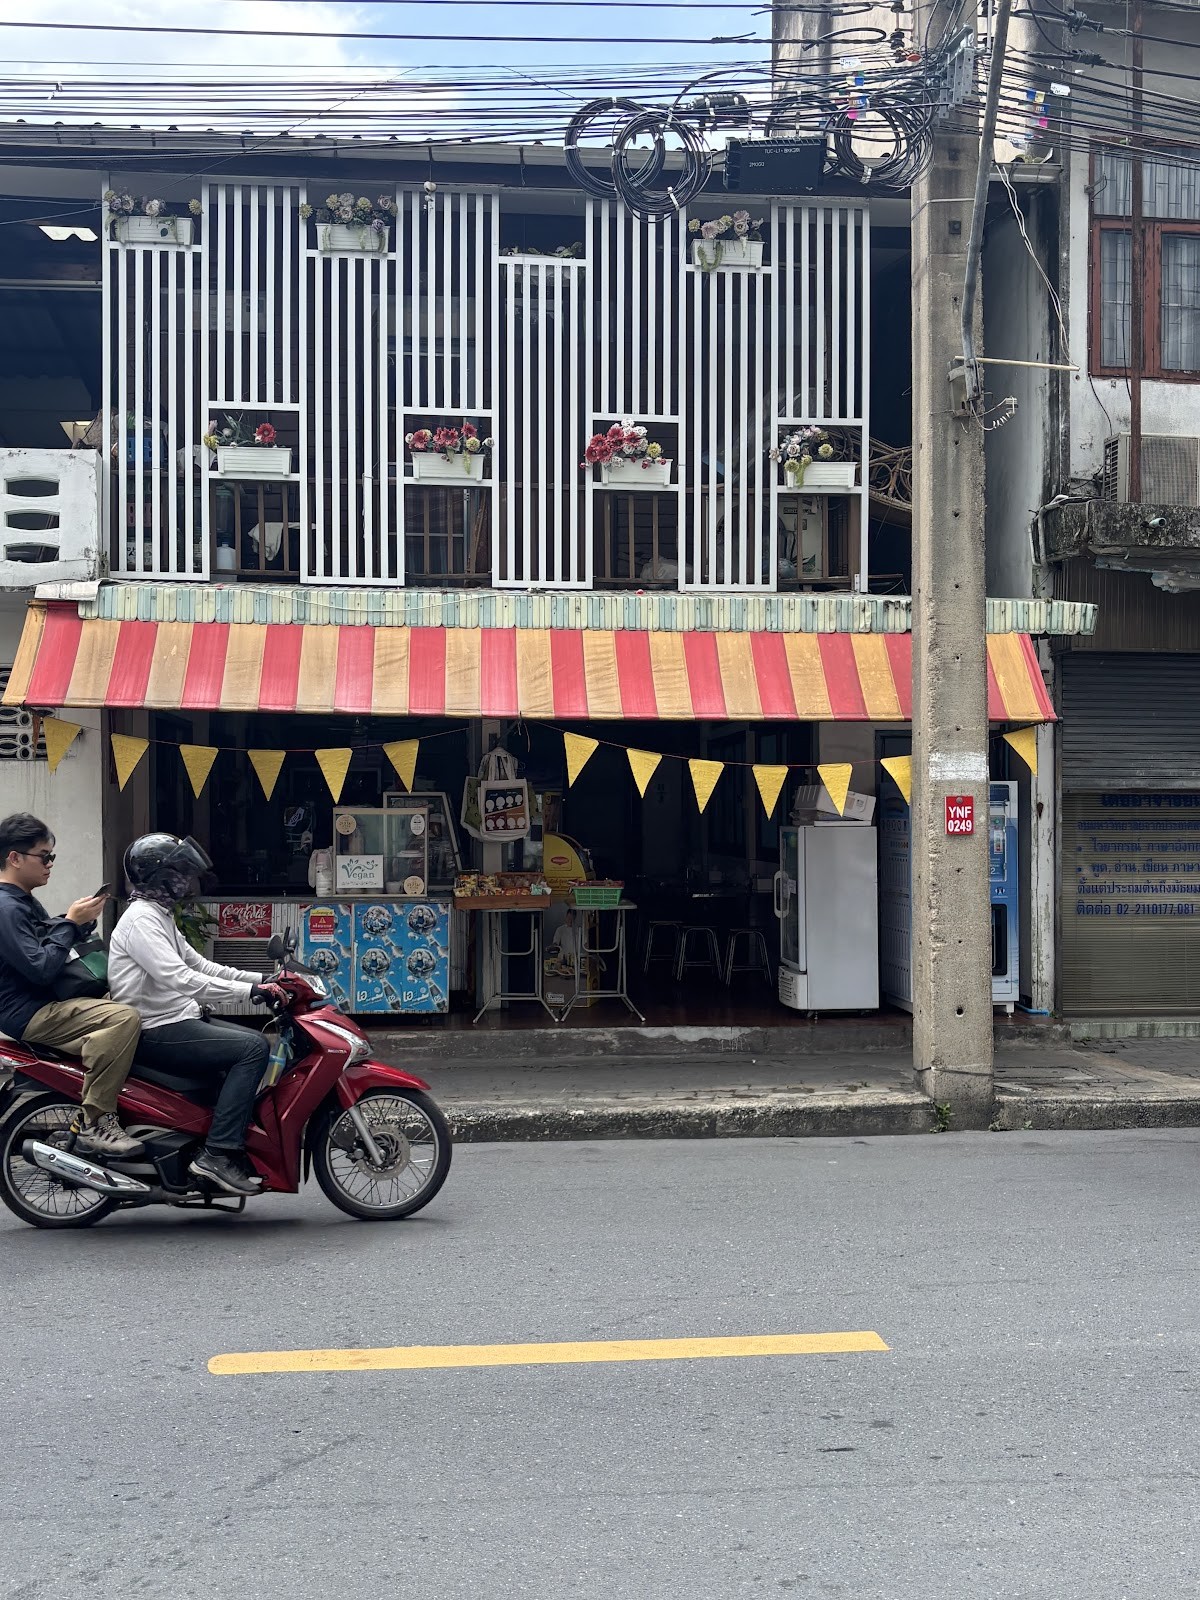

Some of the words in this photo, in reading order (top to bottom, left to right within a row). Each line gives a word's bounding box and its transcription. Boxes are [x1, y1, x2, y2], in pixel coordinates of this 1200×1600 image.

[948, 806, 972, 819] YNF
[947, 819, 973, 833] 0249
[341, 863, 376, 881] Vegan
[1076, 899, 1111, 915] ติดต่อ
